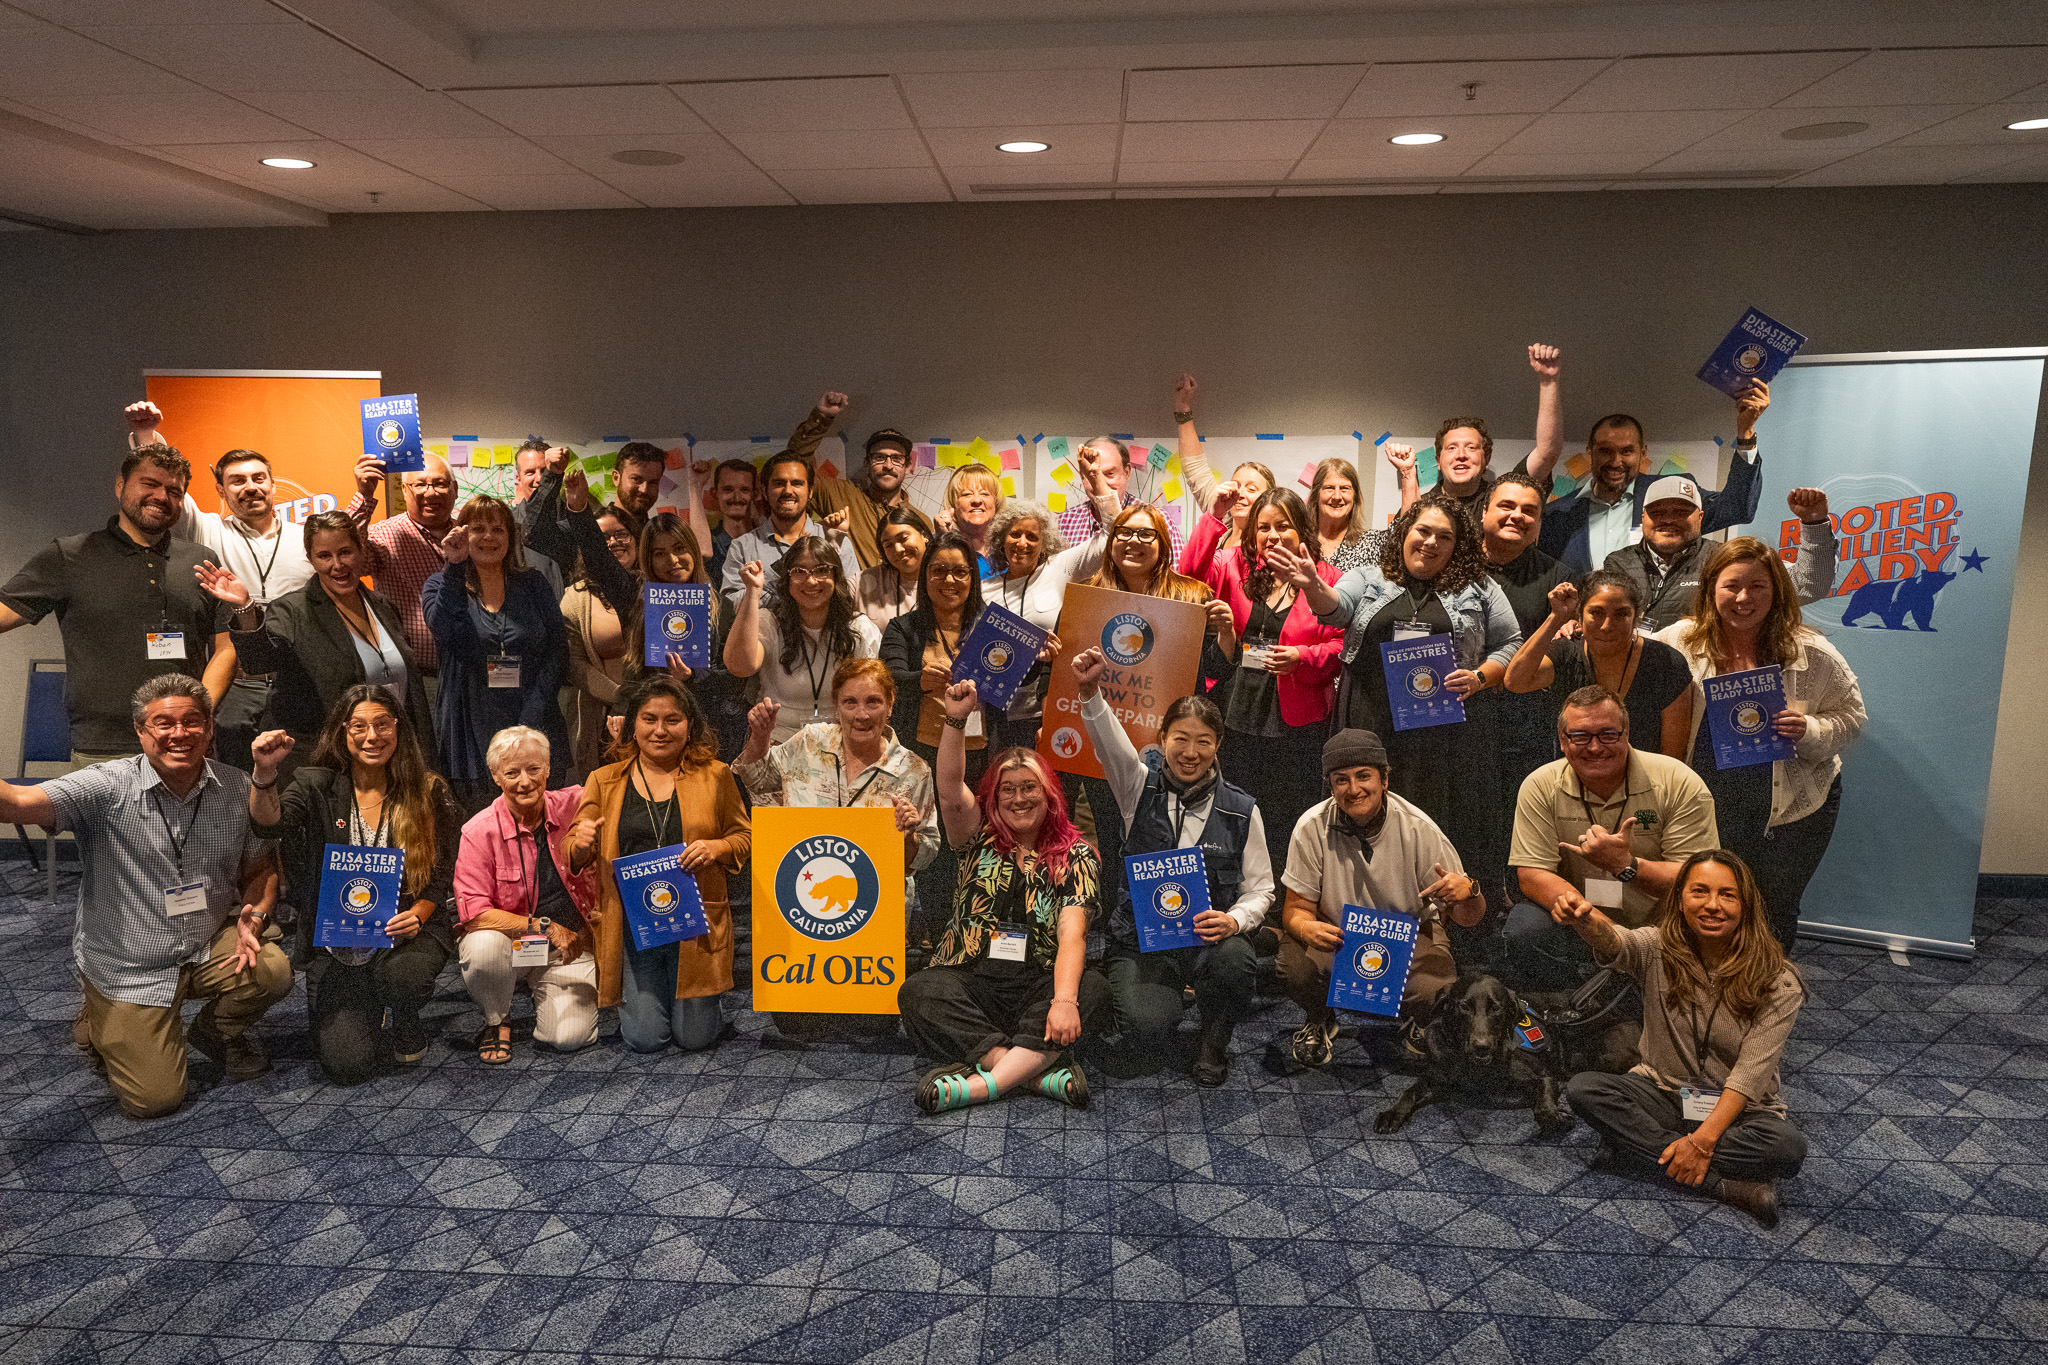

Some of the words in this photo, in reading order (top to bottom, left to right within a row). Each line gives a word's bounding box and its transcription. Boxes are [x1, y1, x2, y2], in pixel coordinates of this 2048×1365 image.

[1741, 322, 1767, 340] READY
[1766, 338, 1791, 354] GUIDE
[1746, 314, 1797, 349] DISASTER
[1748, 345, 1766, 358] LISTOS
[1735, 358, 1756, 372] CALIFORNIA
[364, 400, 412, 413] DISASTER
[365, 410, 388, 419] READY
[389, 408, 413, 416] GUIDE
[274, 493, 343, 525] TED.
[1779, 492, 1963, 548] ROTED.
[1779, 519, 1960, 571] RILIENT.
[1826, 543, 1959, 598] ADY
[649, 588, 705, 599] DISASTER
[678, 598, 704, 606] GUIDE
[1115, 614, 1148, 631] LISTOS
[666, 630, 689, 640] CALIFORNIA
[986, 615, 1038, 649] DESASTRES
[1030, 633, 1040, 642] PARA
[994, 642, 1012, 655] LISTOS
[1106, 646, 1146, 664] CALIFORNIA
[1388, 646, 1448, 664] DESASTRES
[984, 656, 1005, 671] CALIFORNIA
[1100, 667, 1124, 685] SK
[1126, 674, 1154, 690] ME
[1412, 668, 1432, 676] LISTOS
[1709, 673, 1776, 694] DISASTER
[1101, 686, 1128, 704] OW
[1132, 692, 1156, 709] TO
[1412, 686, 1437, 697] CALIFORNIA
[1711, 689, 1742, 702] READY
[1745, 683, 1776, 695] GUIDE
[1056, 697, 1081, 715] GE
[1736, 702, 1758, 712] LISTOS
[1736, 721, 1764, 732] CALIFORNIA
[330, 851, 396, 866] DISASTER
[794, 838, 860, 864] LISTOS
[330, 862, 362, 872] READY
[364, 864, 396, 874] GUIDE
[638, 857, 668, 868] PREPARACIÓN
[1132, 854, 1198, 874] DISASTER
[1134, 870, 1165, 881] READY
[1168, 864, 1198, 876] GUIDE
[350, 880, 372, 889] LISTOS
[648, 882, 669, 892] LISTOS
[1158, 884, 1180, 894] LISTOS
[344, 902, 373, 912] CALIFORNIA
[650, 900, 676, 912] CALIFORNIA
[1160, 904, 1186, 916] CALIFORNIA
[788, 906, 868, 936] CALIFORNIA
[1348, 912, 1412, 934] DISASTER
[1346, 923, 1378, 936] READY
[1380, 930, 1410, 942] GUIDE
[1364, 944, 1386, 955] LISTOS
[760, 953, 816, 984] Cal
[823, 955, 896, 986] OES
[1356, 964, 1384, 977] CALIFORNIA
